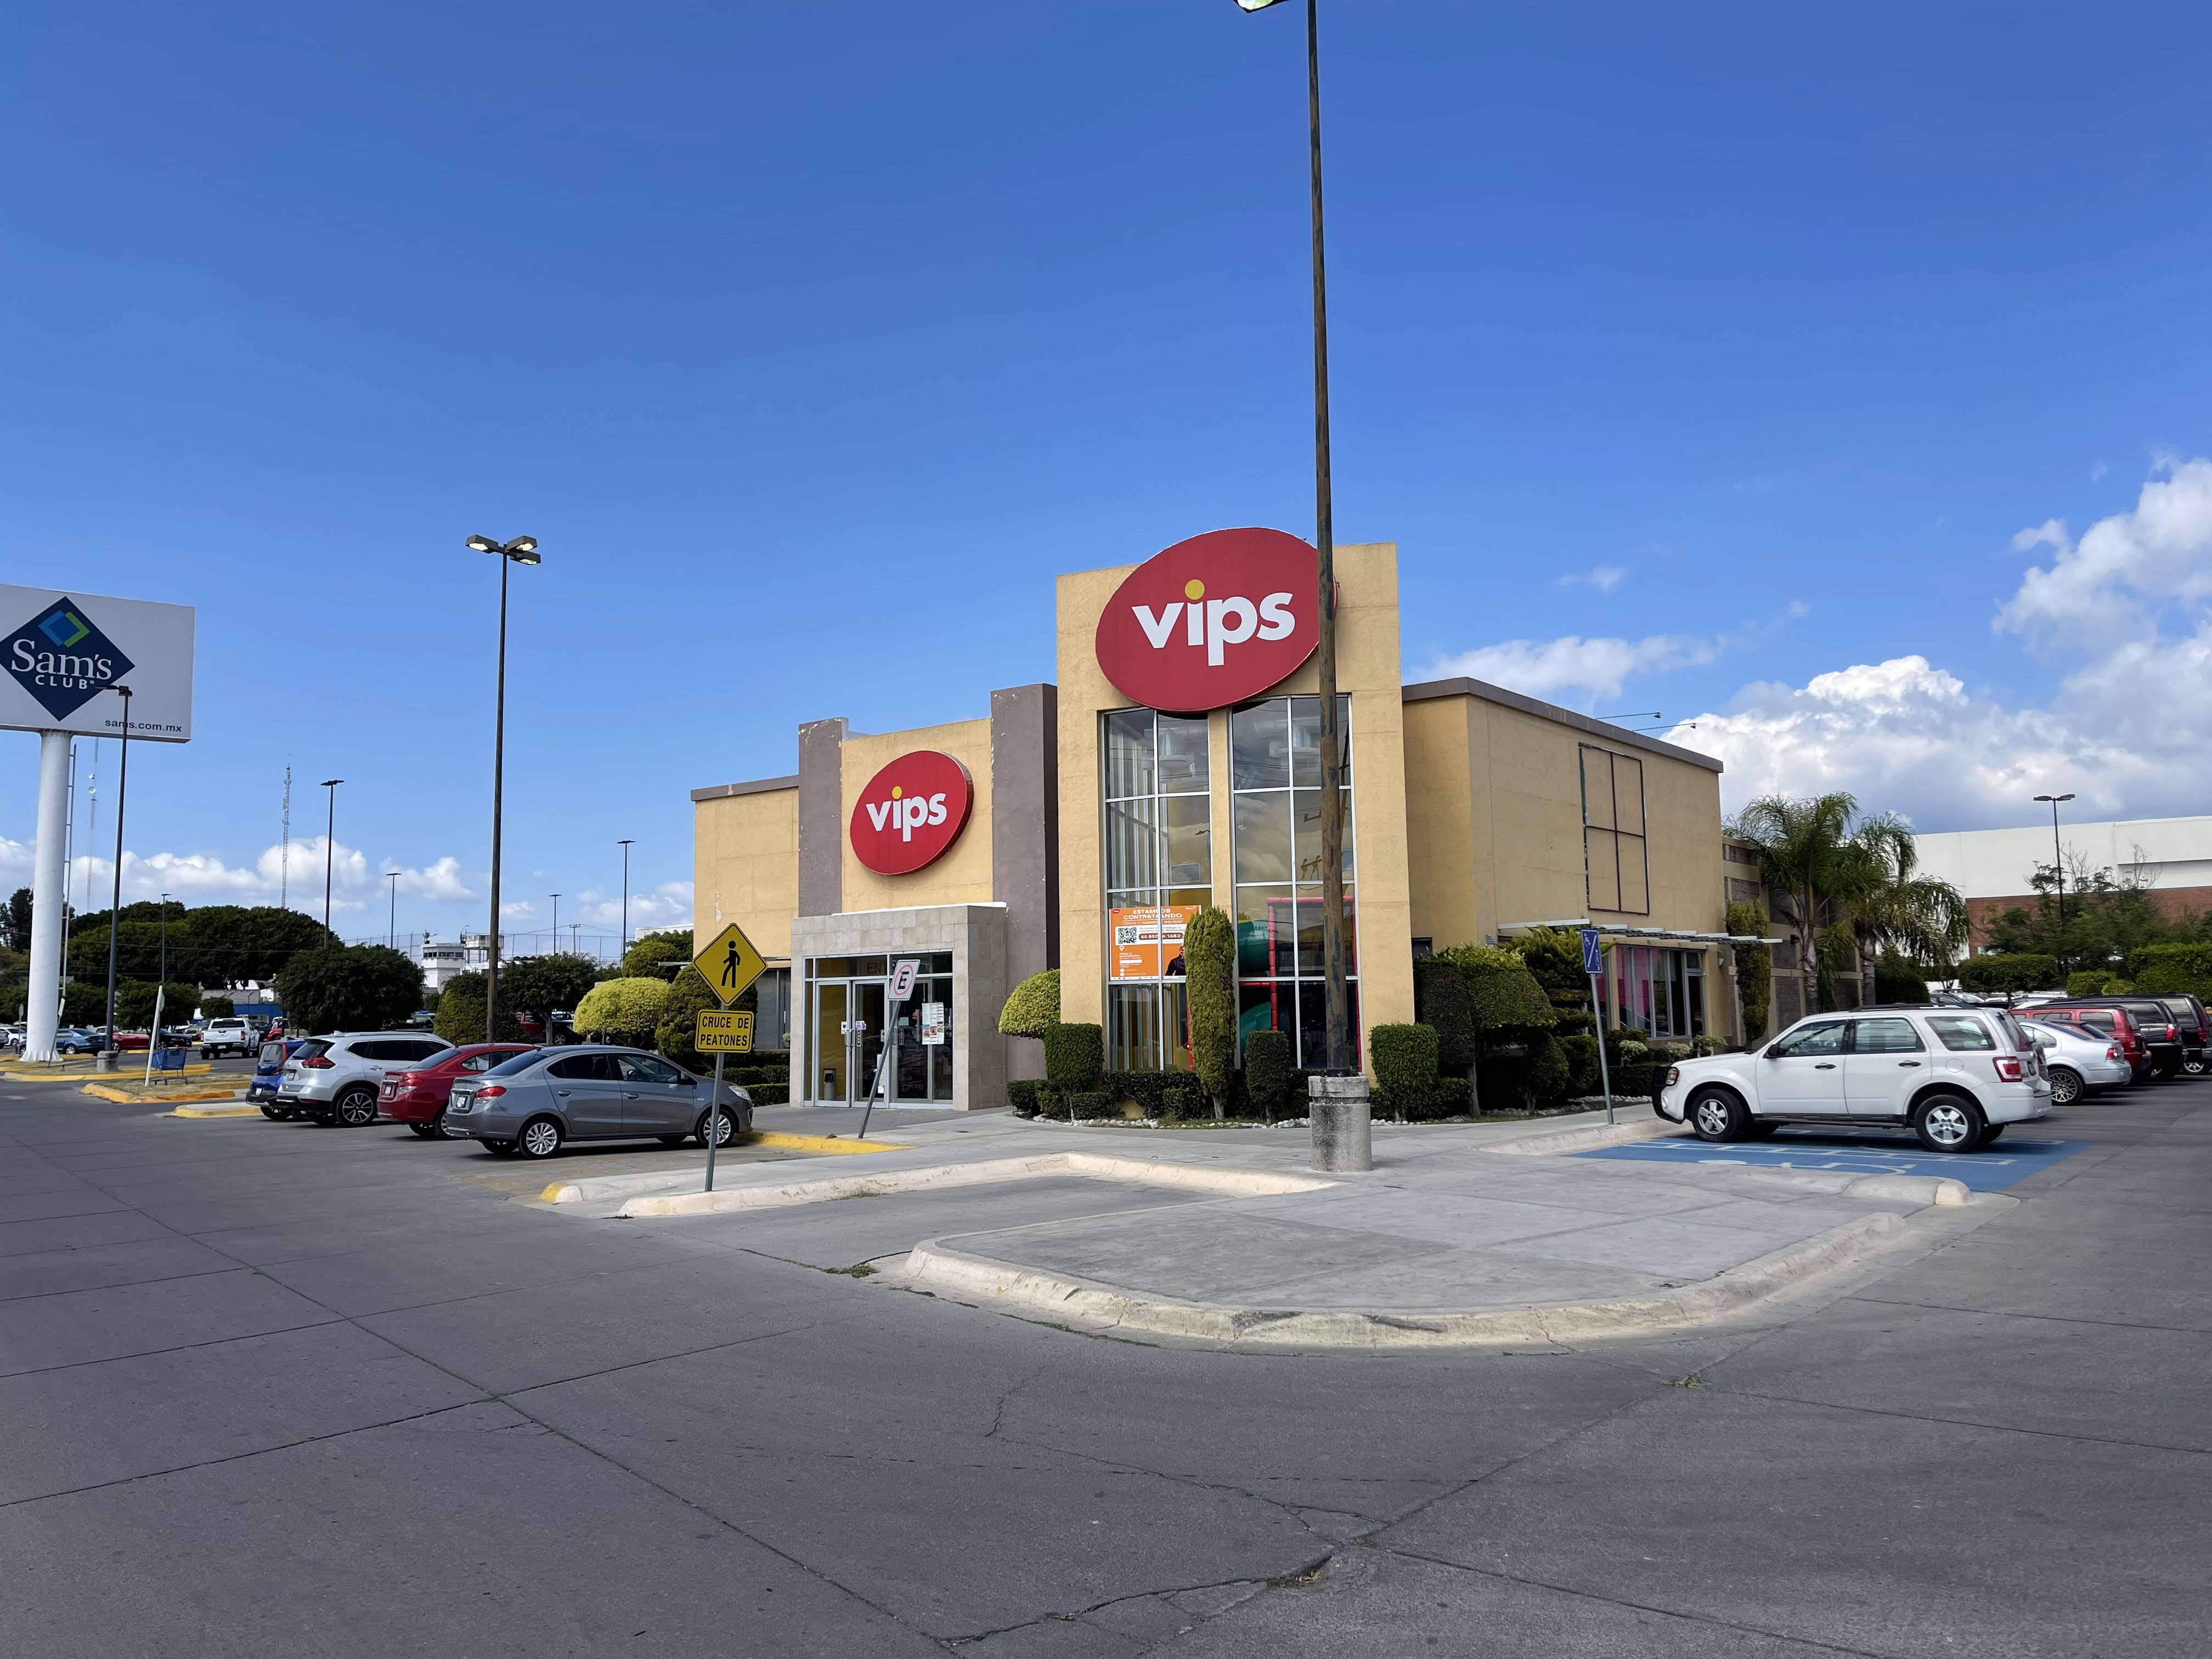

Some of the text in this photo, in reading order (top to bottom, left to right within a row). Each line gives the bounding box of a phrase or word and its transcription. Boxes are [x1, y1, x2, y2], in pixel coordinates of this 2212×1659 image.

[1131, 579, 1295, 667] vips
[11, 639, 112, 680] Sam's
[35, 674, 88, 690] CLUB
[105, 719, 182, 732] sams.com.mx
[865, 786, 947, 842] vips
[897, 971, 910, 990] E
[702, 1015, 749, 1029] CRUCE DE
[700, 1034, 747, 1046] PEATONES
